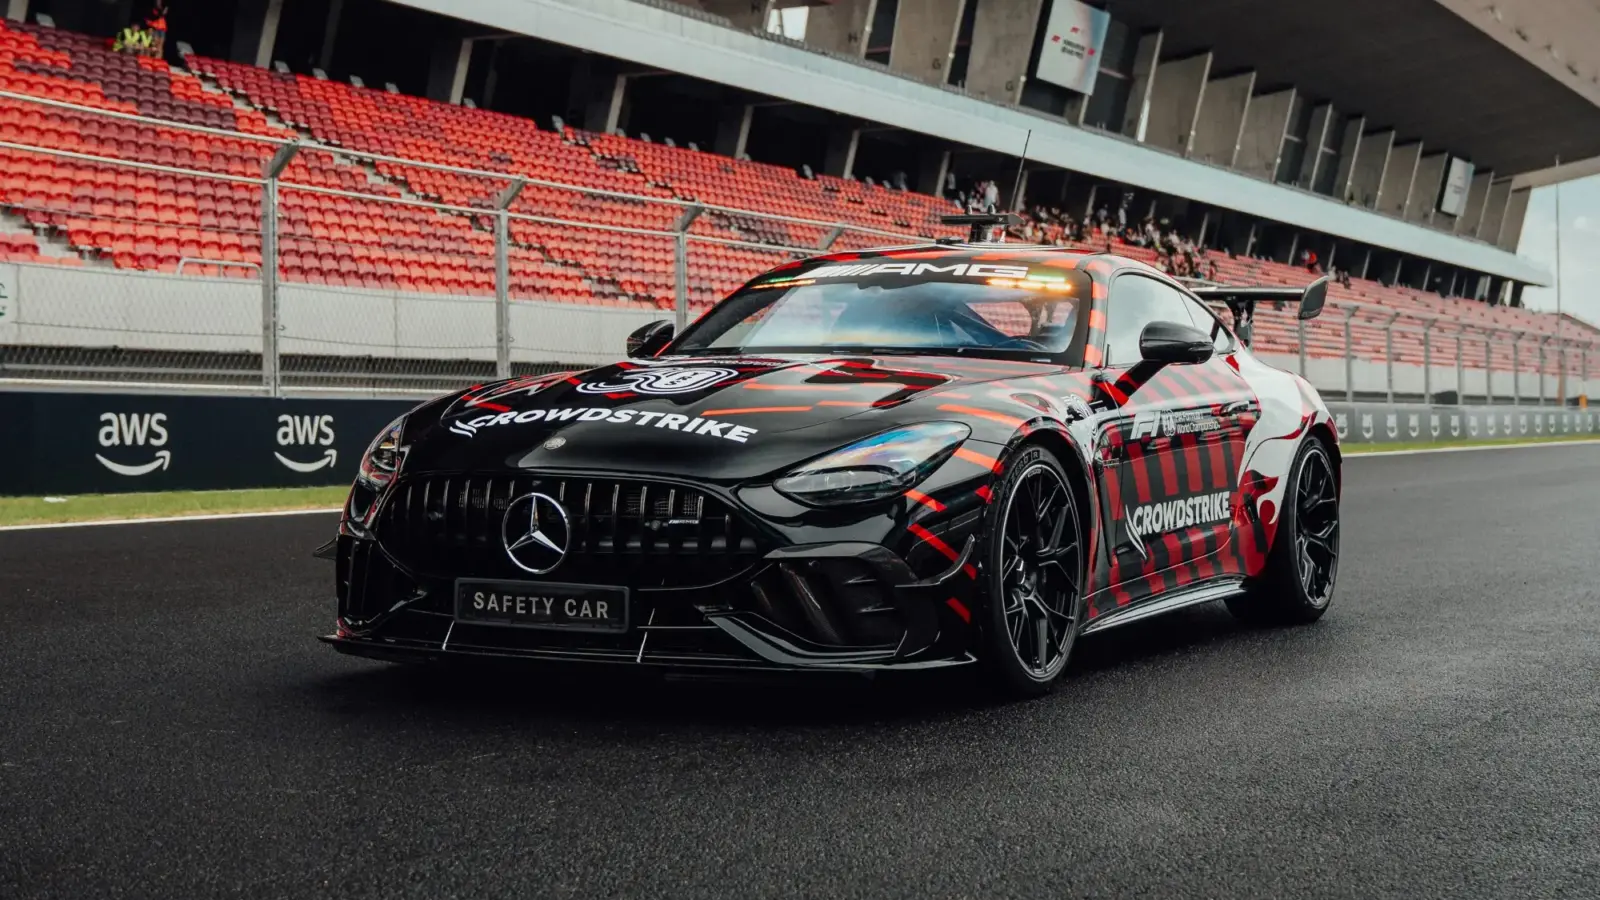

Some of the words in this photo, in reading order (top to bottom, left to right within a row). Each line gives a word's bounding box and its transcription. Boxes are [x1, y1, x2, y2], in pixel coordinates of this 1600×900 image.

[98, 412, 168, 447] aws
[276, 414, 335, 446] aws
[467, 408, 758, 443] CROWDSTRIKE
[1132, 491, 1230, 536] CROWDSTRIKE
[473, 591, 554, 615] SAFETY
[564, 598, 609, 619] CAR
